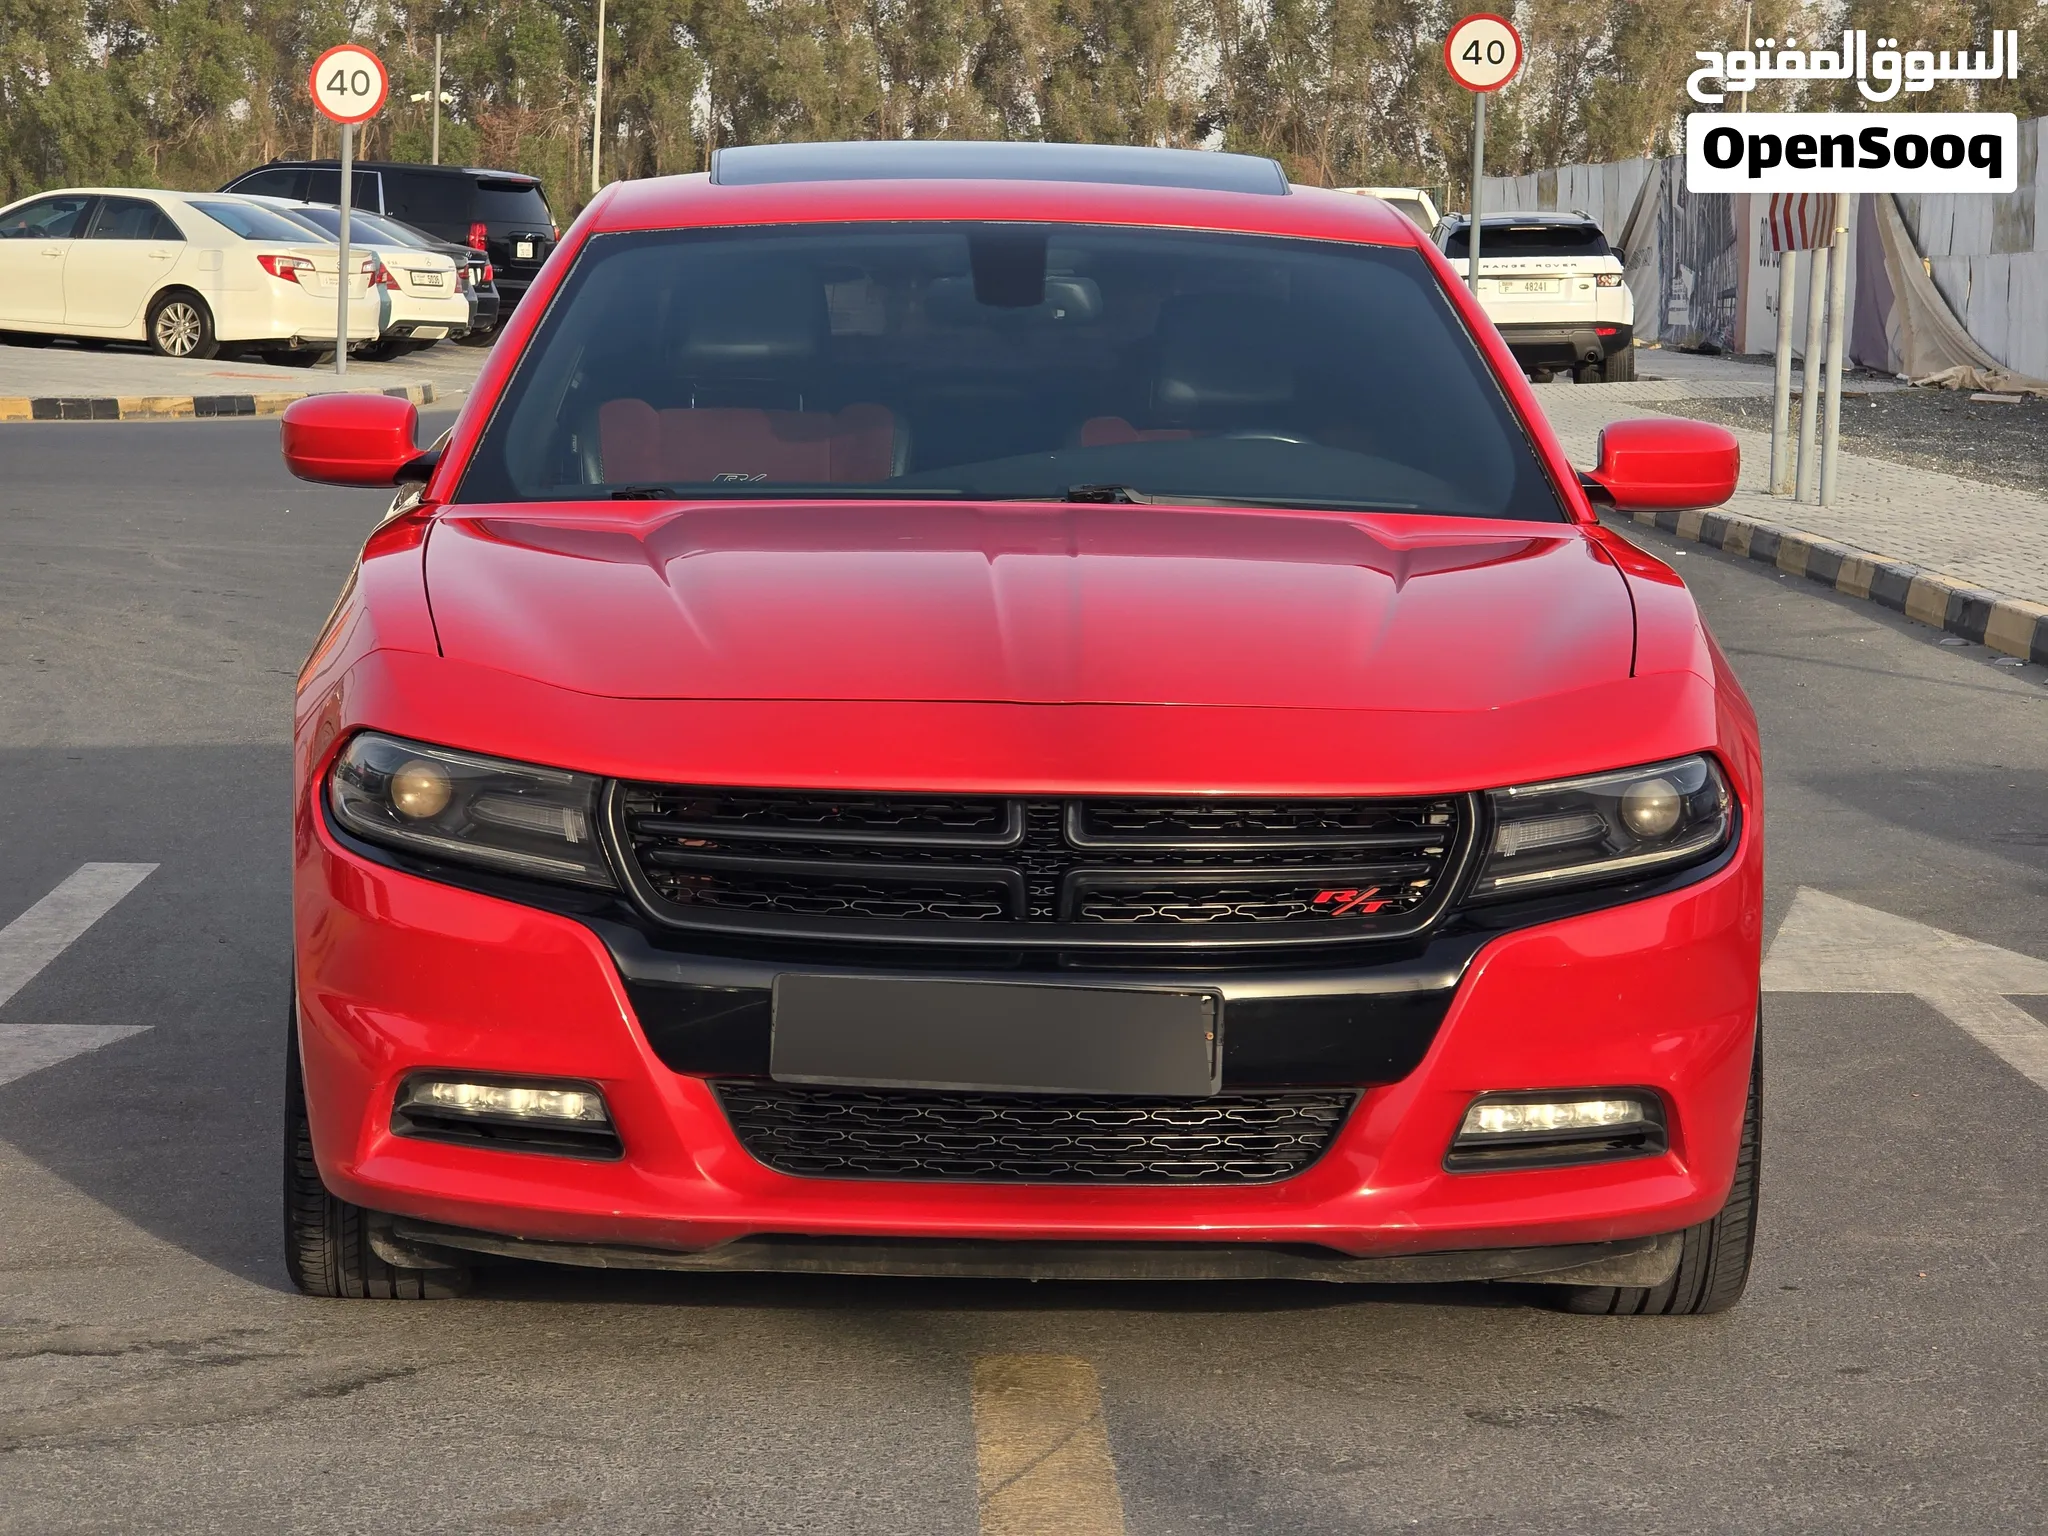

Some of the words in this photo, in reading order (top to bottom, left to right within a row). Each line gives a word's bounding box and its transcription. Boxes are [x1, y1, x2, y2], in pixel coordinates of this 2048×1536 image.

[1462, 40, 1505, 65] 40
[326, 69, 370, 96] 40
[1524, 281, 1547, 292] 48241
[1313, 887, 1393, 916] R/T
